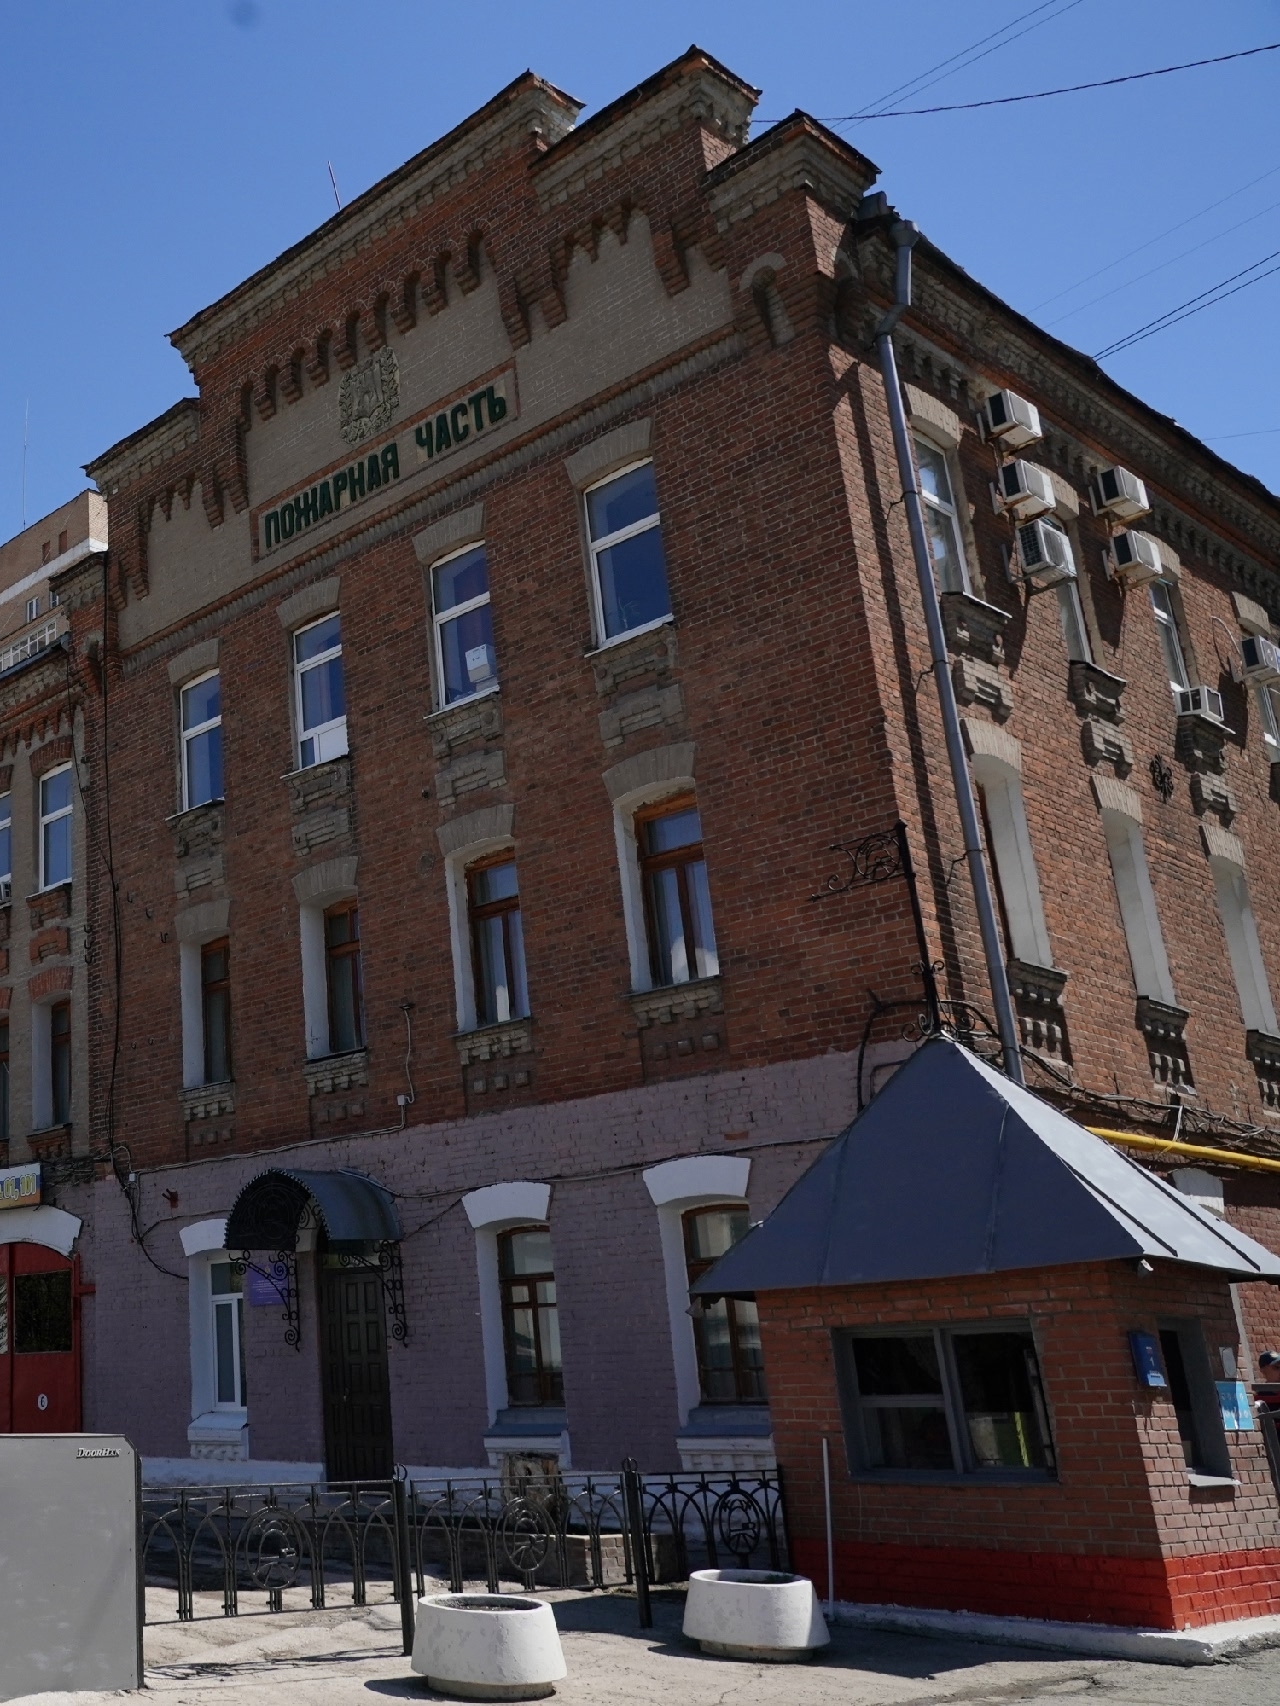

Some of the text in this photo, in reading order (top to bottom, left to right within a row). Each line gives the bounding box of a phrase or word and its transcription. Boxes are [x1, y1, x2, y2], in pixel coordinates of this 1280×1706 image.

[264, 386, 507, 549] ПОЖАРНАЯ ЧАСТЬ
[20, 1173, 36, 1196] 101
